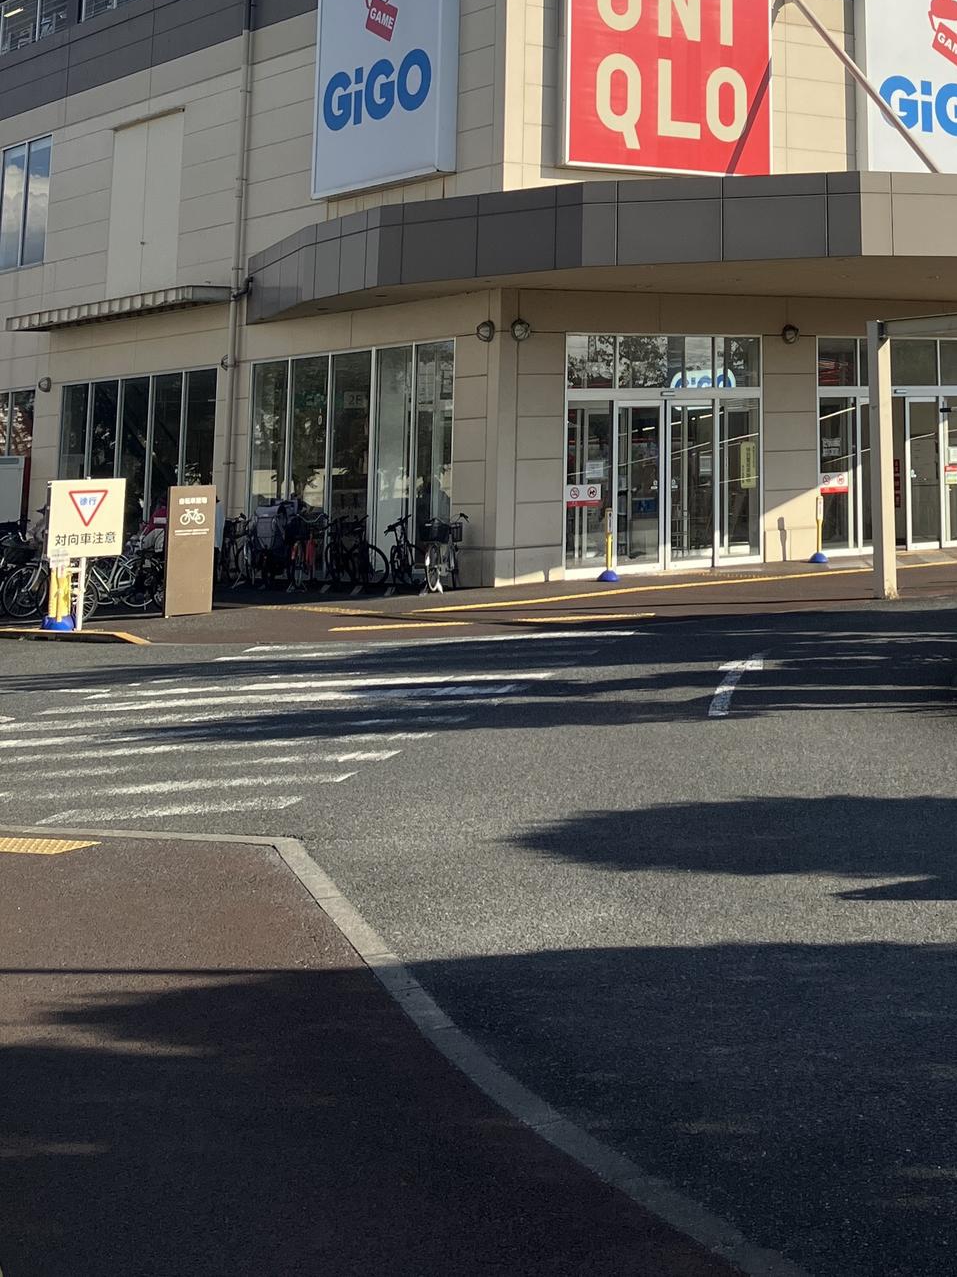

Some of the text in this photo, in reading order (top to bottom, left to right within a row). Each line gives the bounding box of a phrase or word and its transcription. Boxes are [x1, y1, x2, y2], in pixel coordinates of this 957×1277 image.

[369, 5, 395, 30] GAME
[323, 48, 432, 132] GiGO
[595, 52, 748, 150] QLO
[54, 531, 117, 547] 対向車注意
